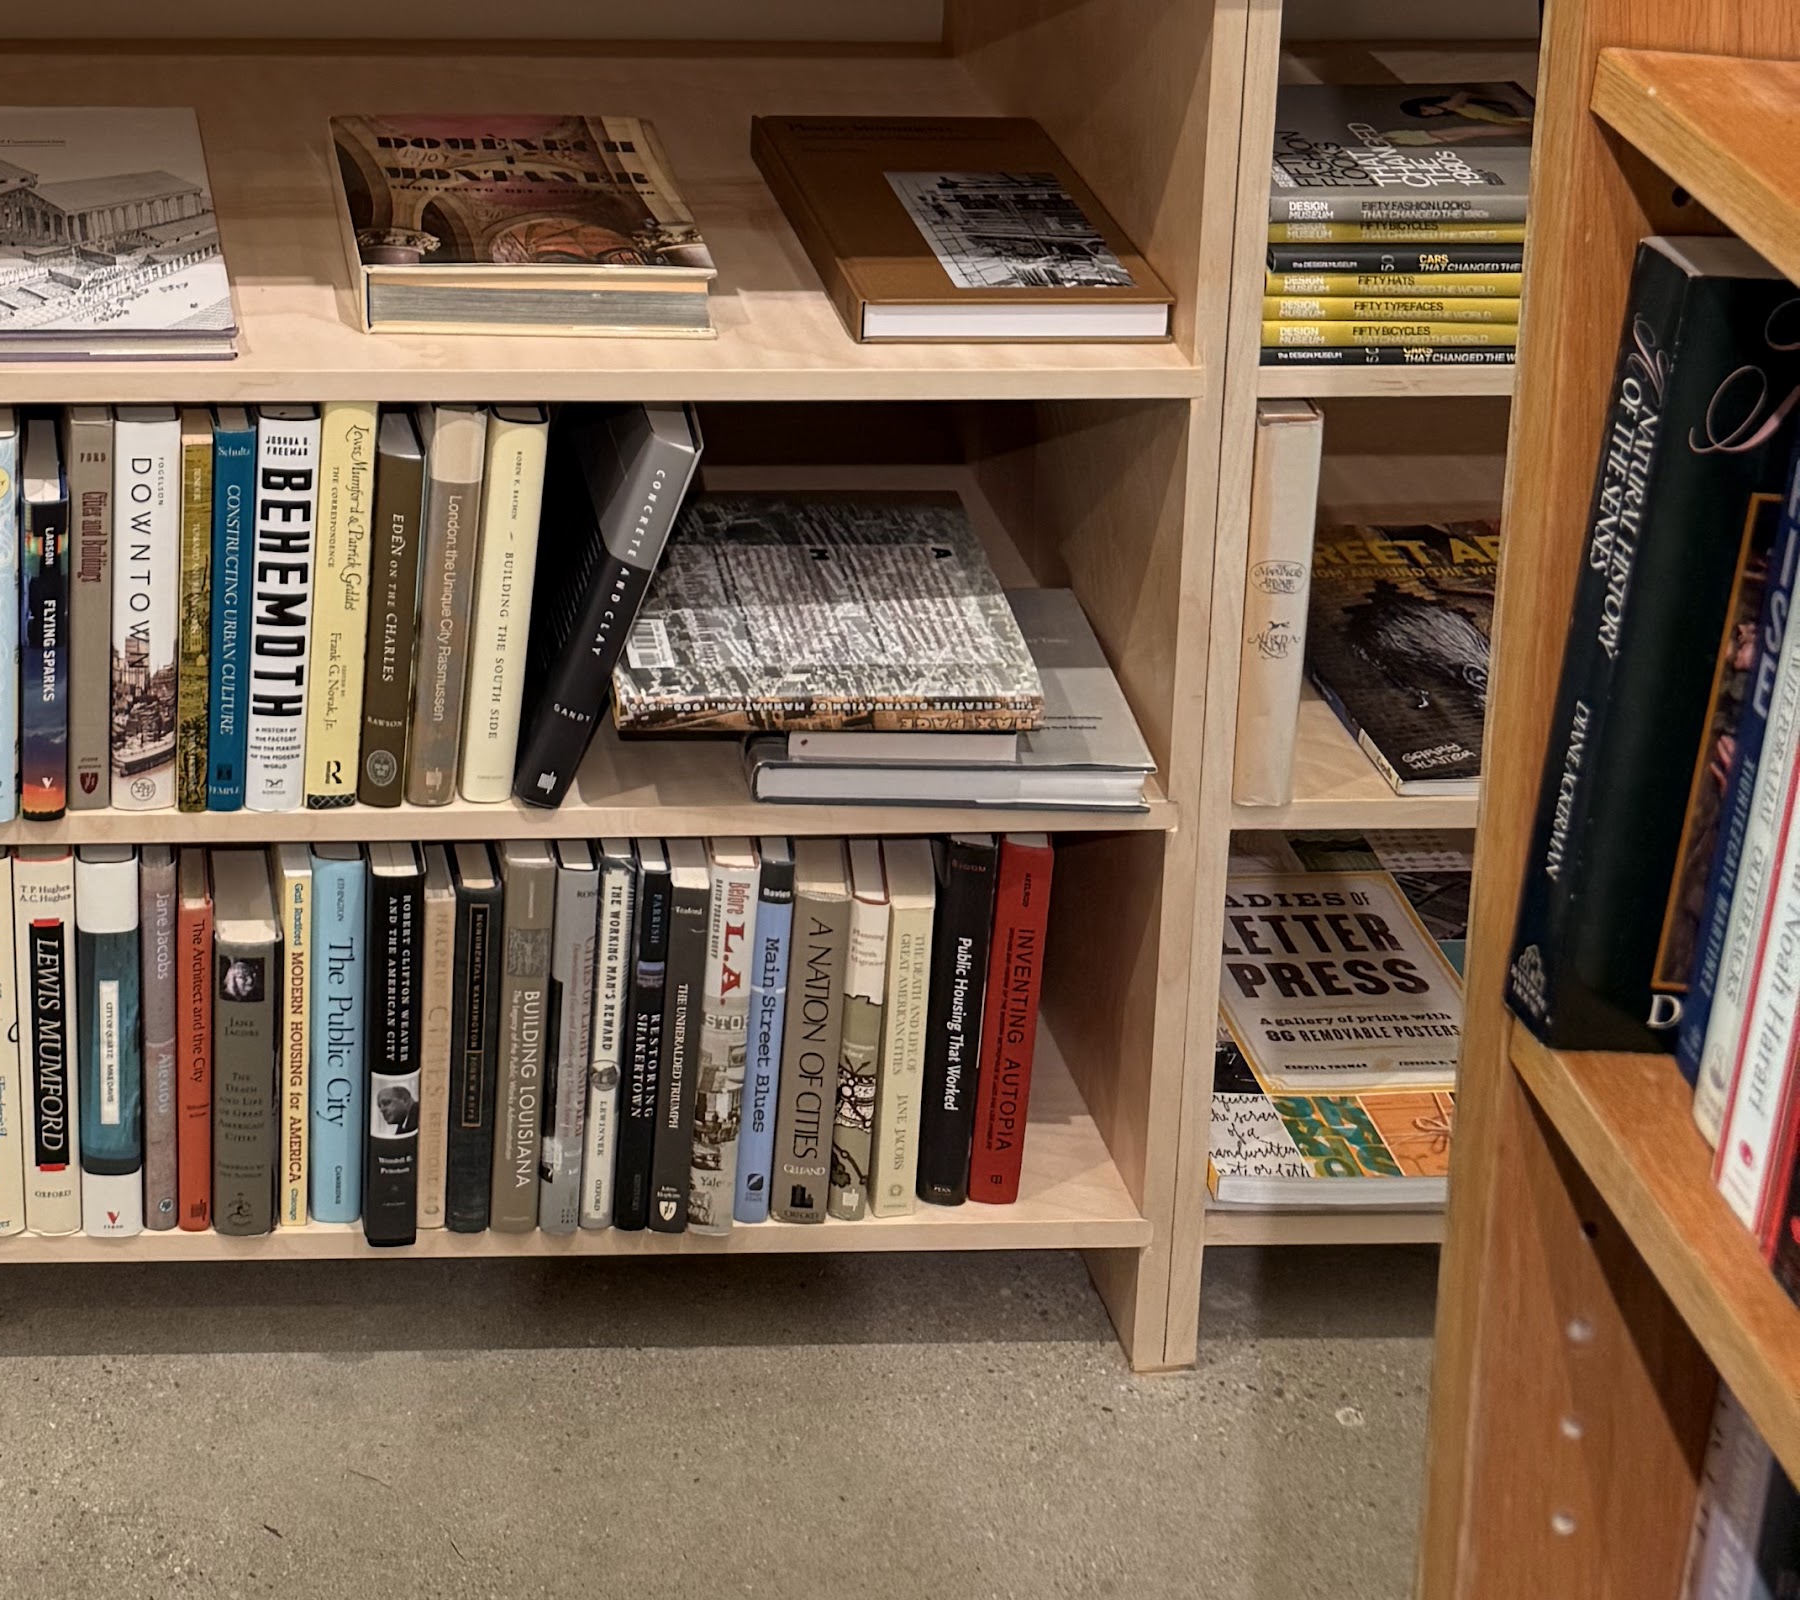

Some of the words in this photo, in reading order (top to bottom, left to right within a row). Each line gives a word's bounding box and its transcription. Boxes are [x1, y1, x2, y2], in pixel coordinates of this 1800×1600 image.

[1288, 211, 1334, 219] MUSEUM
[1289, 202, 1328, 211] DESIGN
[1355, 301, 1380, 312] FIFTY
[1384, 301, 1444, 312] TYPEFACES
[626, 470, 666, 558] CONCRETE
[129, 457, 152, 669] DOWNTOWN
[252, 468, 313, 716] BEHEMOTH
[901, 716, 966, 730] PAGE
[811, 917, 833, 935] A
[37, 939, 59, 1009] LEWIS
[328, 937, 354, 983] The
[1226, 958, 1429, 997] PRESS
[802, 946, 831, 1041] NATION
[328, 996, 353, 1067] Public
[38, 1017, 62, 1149] MUMFORD
[798, 1052, 823, 1086] OF
[316, 1078, 352, 1126] City
[793, 1092, 820, 1158] CITIES
